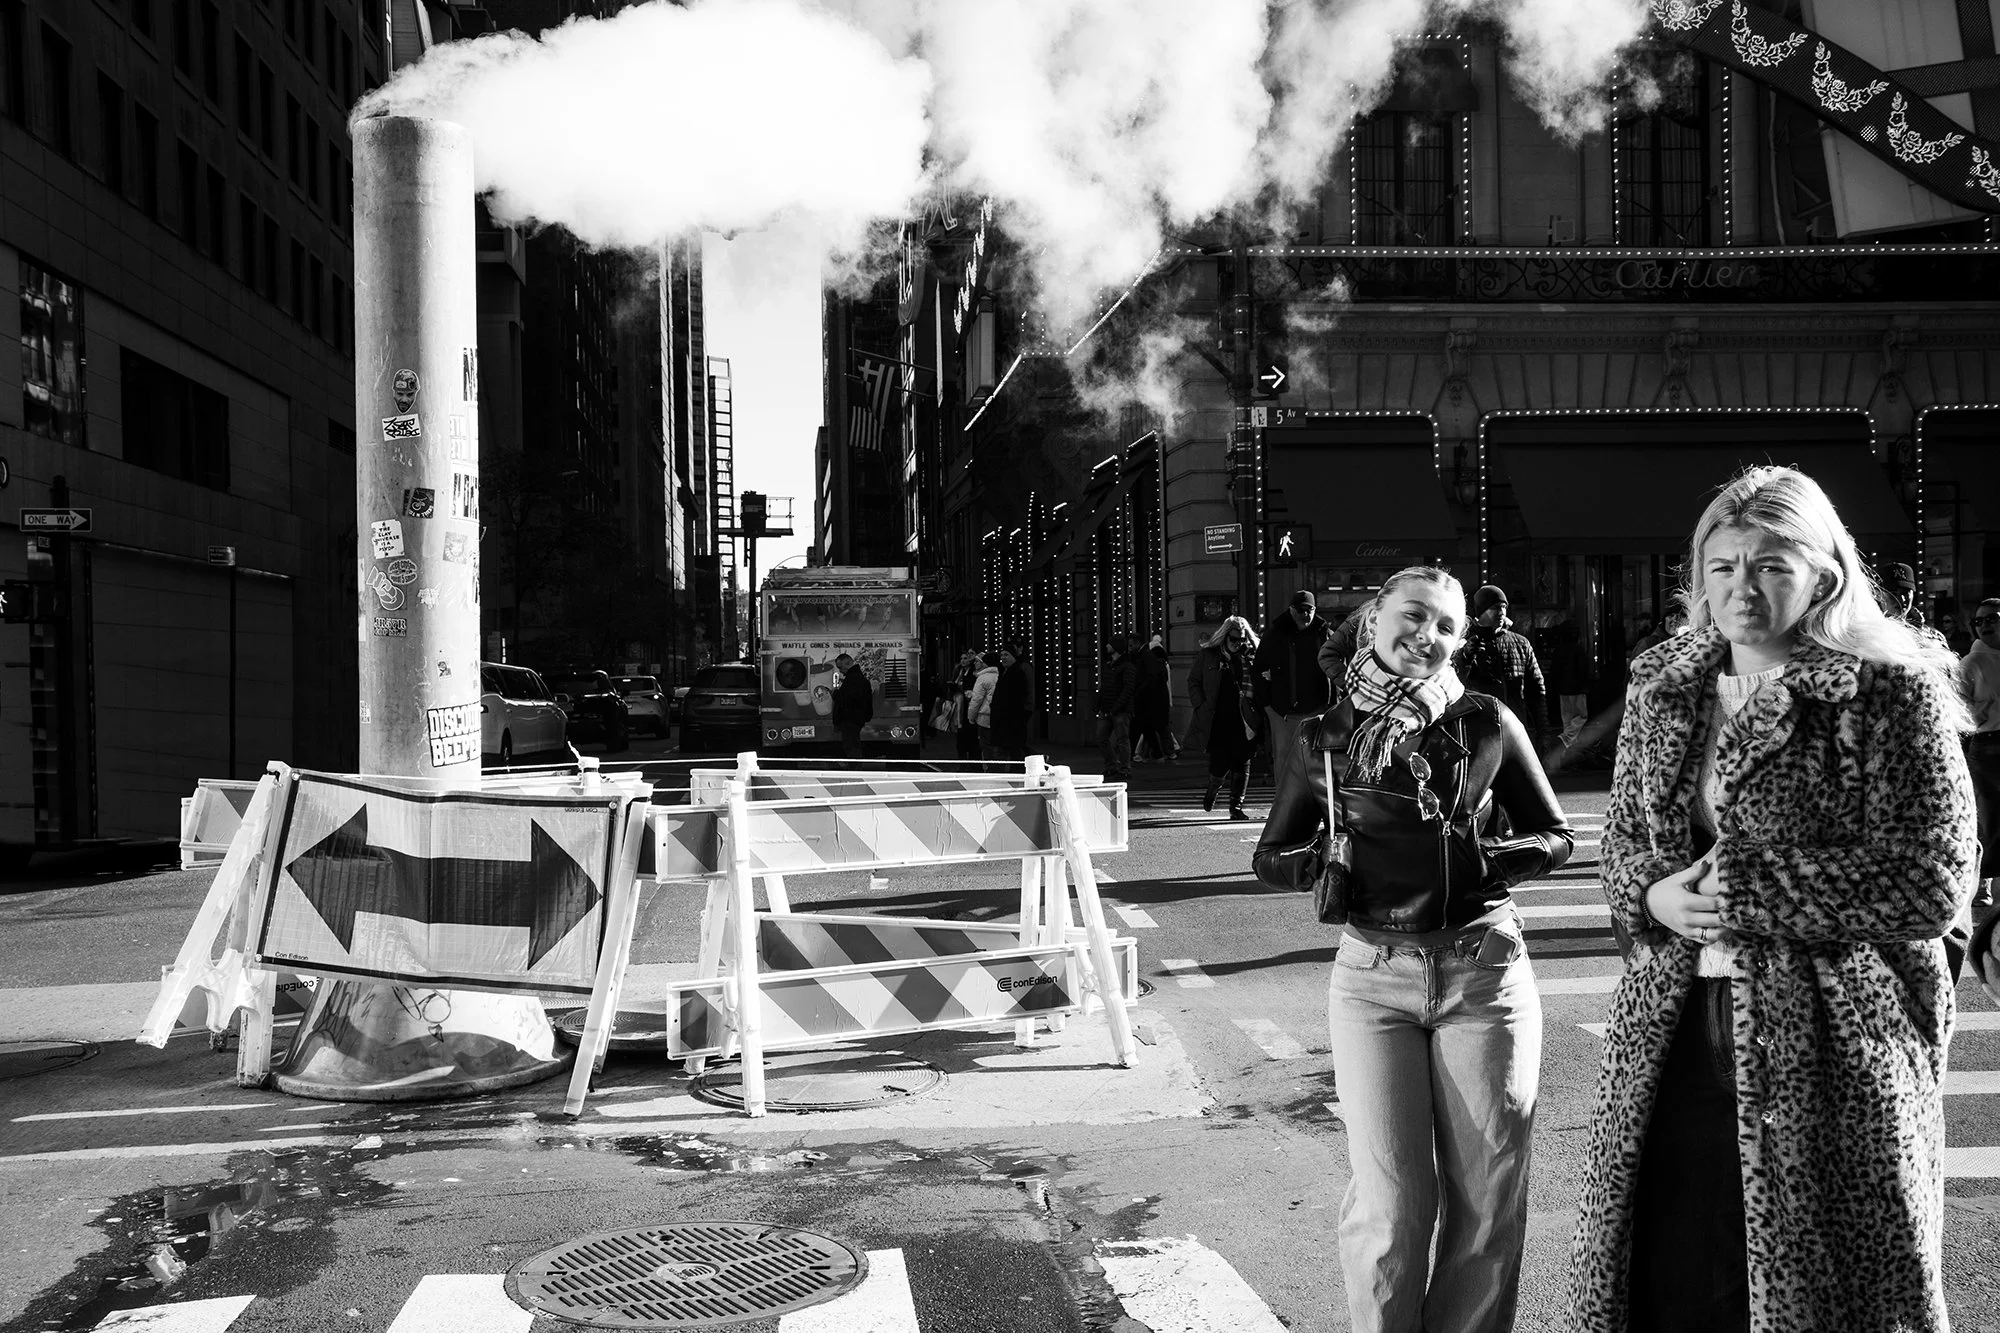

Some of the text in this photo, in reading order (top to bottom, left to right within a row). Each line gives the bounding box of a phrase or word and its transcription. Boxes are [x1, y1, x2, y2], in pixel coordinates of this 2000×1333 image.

[1615, 260, 1756, 288] Cartier
[1276, 409, 1284, 425] 5
[28, 515, 77, 524] ONE WAY
[1214, 527, 1236, 535] STANDING
[1355, 542, 1401, 557] Cartier
[427, 704, 481, 738] DISCOU
[430, 735, 481, 767] BEEPE
[276, 980, 314, 992] conEdis
[1013, 976, 1057, 988] conEdison
